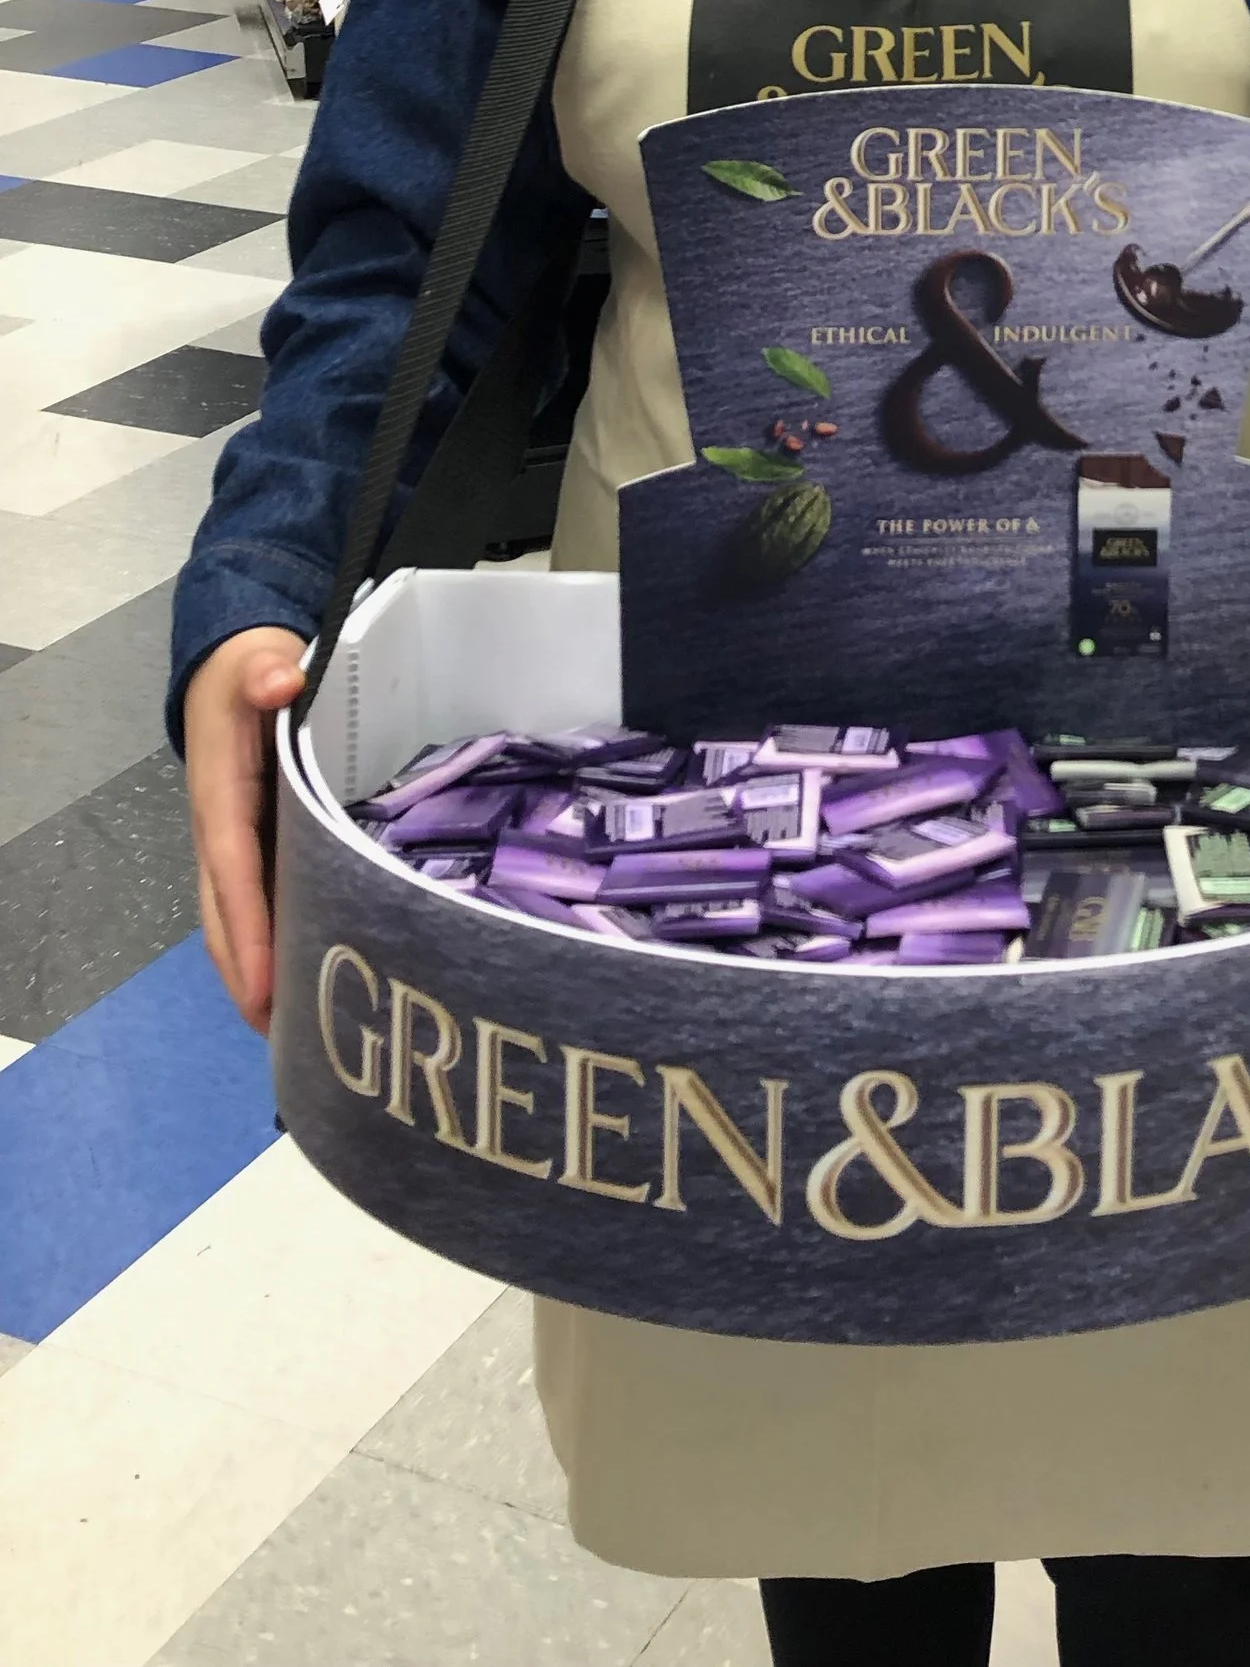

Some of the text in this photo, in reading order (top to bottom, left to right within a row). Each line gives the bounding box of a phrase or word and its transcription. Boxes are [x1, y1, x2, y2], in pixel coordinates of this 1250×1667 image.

[791, 21, 1032, 84] GREEN
[850, 127, 1082, 183] GREEN
[811, 326, 911, 346] ETHICAL
[993, 324, 1133, 344] INDULGENT
[877, 519, 915, 535] THE
[922, 518, 990, 534] POWER
[996, 517, 1021, 533] OF
